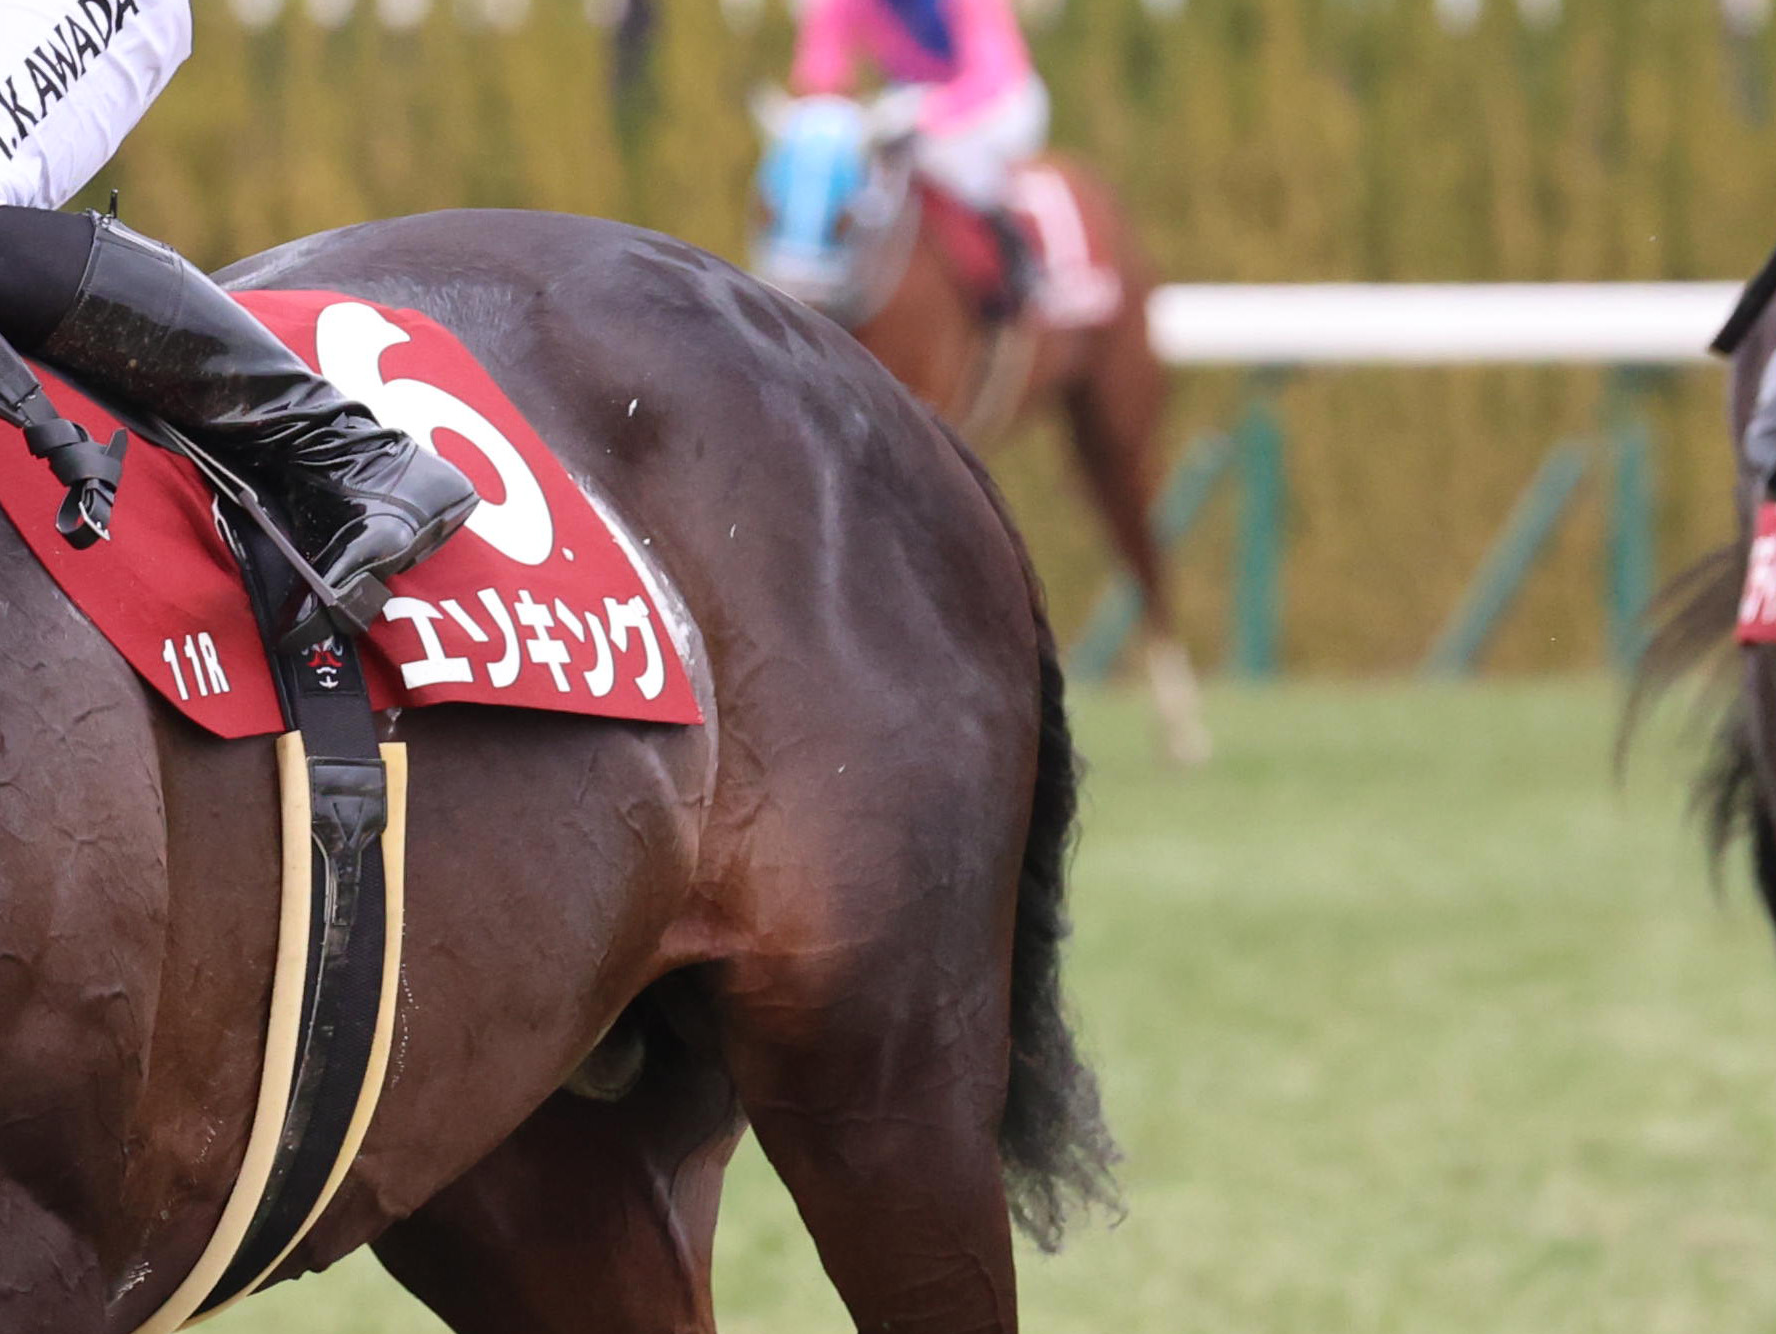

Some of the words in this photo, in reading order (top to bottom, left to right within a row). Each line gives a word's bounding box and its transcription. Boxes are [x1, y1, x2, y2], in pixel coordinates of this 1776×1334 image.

[315, 301, 554, 566] 6
[162, 632, 231, 701] 11R
[382, 587, 667, 700] エリキング
